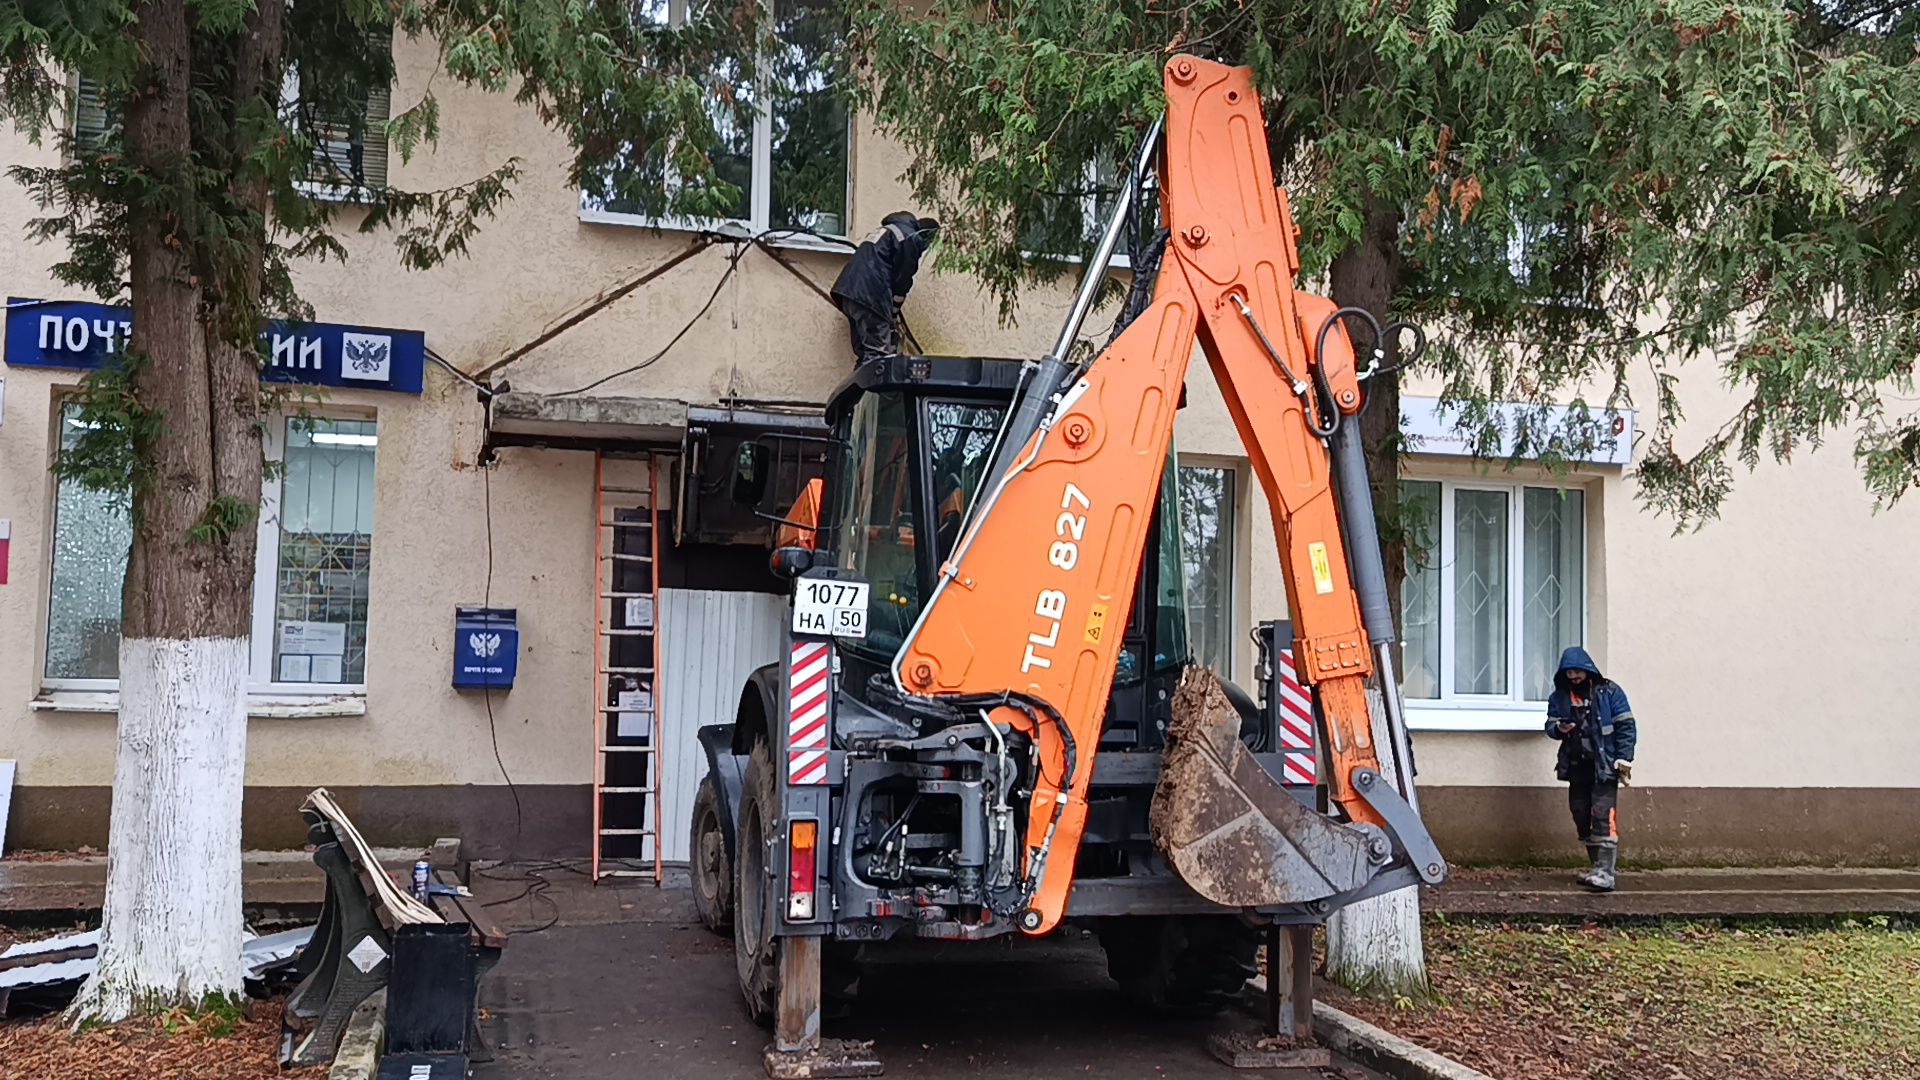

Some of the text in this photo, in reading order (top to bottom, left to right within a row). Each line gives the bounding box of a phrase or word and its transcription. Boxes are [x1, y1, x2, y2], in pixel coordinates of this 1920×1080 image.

[1020, 481, 1092, 674] TLB 827
[807, 583, 859, 607] 1077
[800, 610, 861, 630] НА 50
